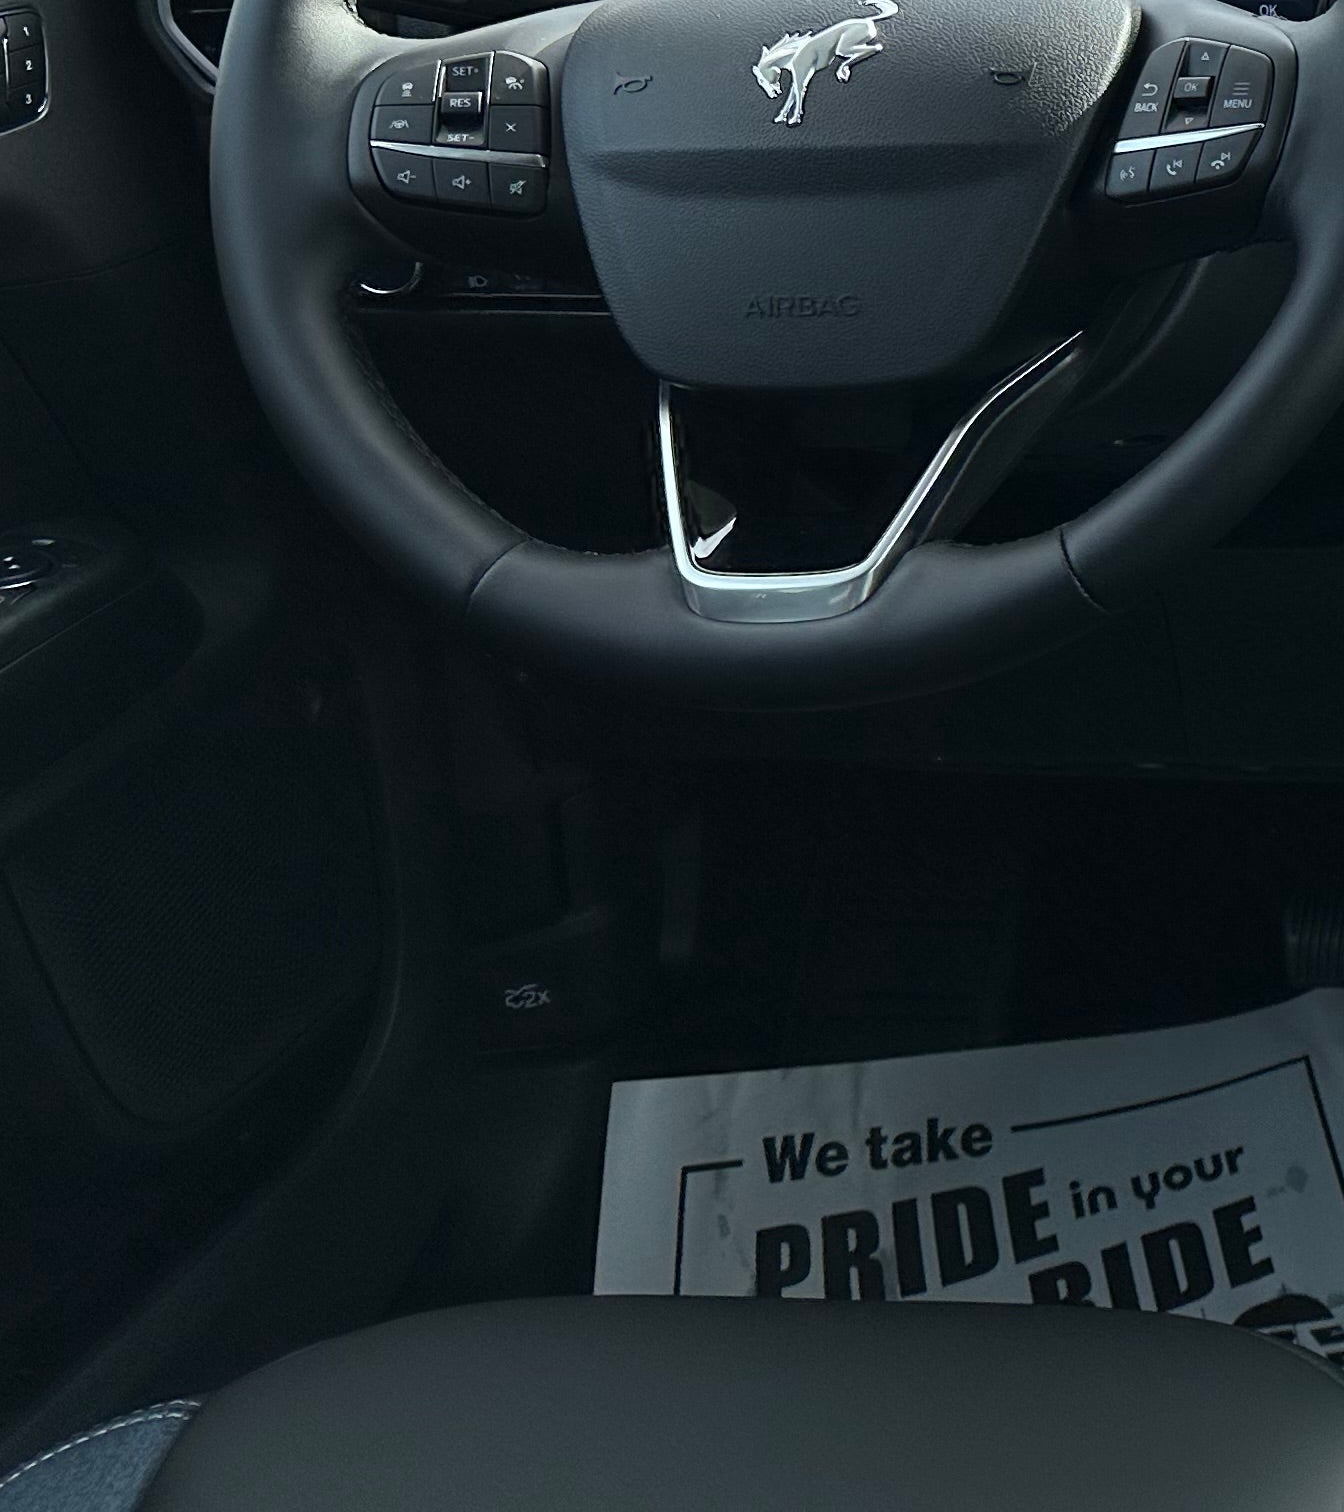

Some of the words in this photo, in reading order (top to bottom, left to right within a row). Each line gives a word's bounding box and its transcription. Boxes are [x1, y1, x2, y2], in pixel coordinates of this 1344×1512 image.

[1259, 4, 1277, 17] OK
[25, 60, 32, 70] 2
[1184, 82, 1197, 92] OK
[25, 94, 32, 104] 3
[450, 98, 471, 108] RES
[1223, 98, 1253, 109] MENU
[1134, 101, 1158, 112] BACK
[745, 295, 861, 319] AIRBAG
[761, 1129, 851, 1185] We
[865, 1116, 996, 1175] take
[755, 1166, 1062, 1301] PRIDE
[1068, 1178, 1119, 1221] in
[1130, 1143, 1246, 1211] your
[1028, 1194, 1276, 1313] RIDE
